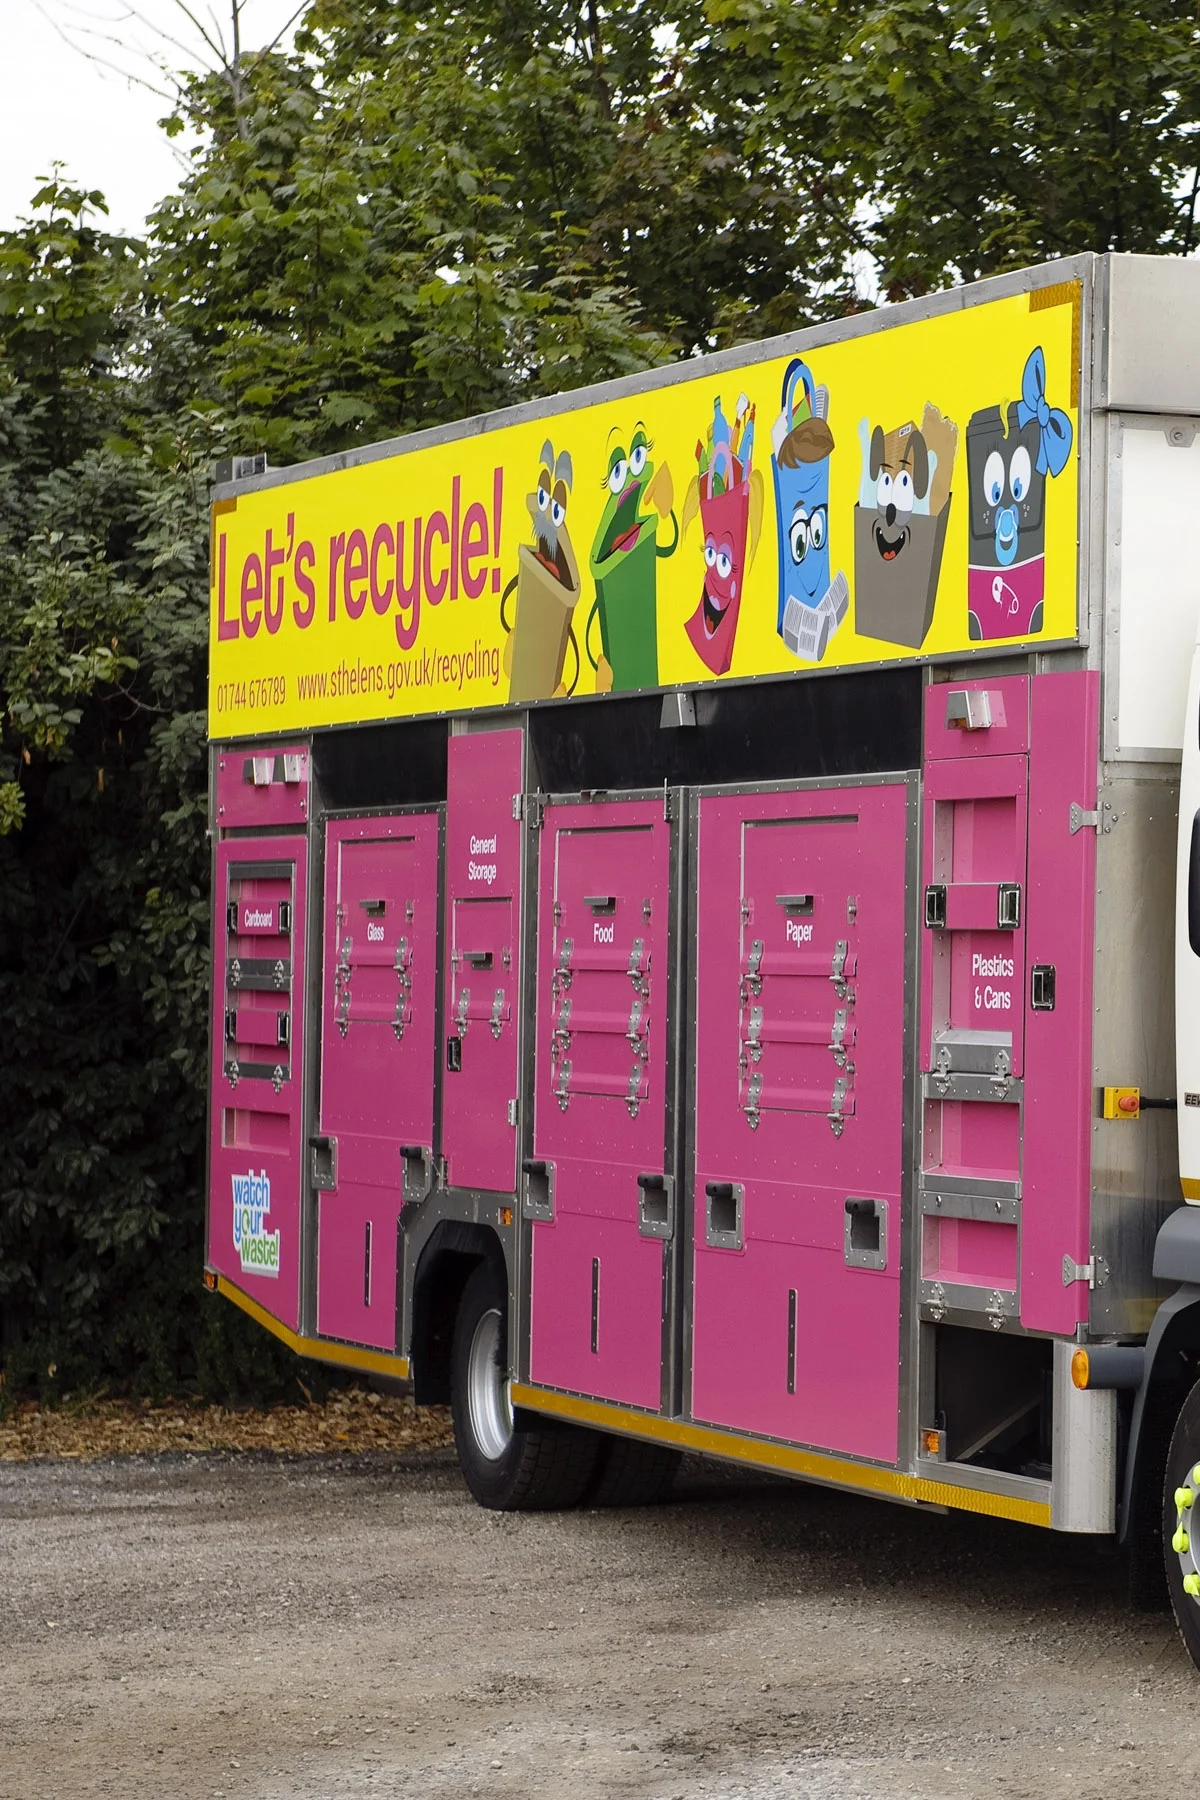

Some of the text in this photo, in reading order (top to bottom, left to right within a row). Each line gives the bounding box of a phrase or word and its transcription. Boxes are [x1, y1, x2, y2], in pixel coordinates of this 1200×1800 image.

[217, 466, 504, 651] Let's recycle!
[217, 639, 500, 712] 01744 676789 www.sthelens.gov.uk/recycling
[469, 834, 497, 854] General
[468, 861, 497, 885] Storage
[244, 909, 273, 928] Cardboard
[367, 923, 385, 941] Glass
[593, 923, 614, 943] Food
[786, 920, 813, 948] Paper
[972, 953, 1014, 977] Plastics
[974, 985, 1011, 1009] & Cans
[234, 1174, 269, 1208] watch
[235, 1207, 261, 1243] your
[241, 1233, 279, 1267] waste!
